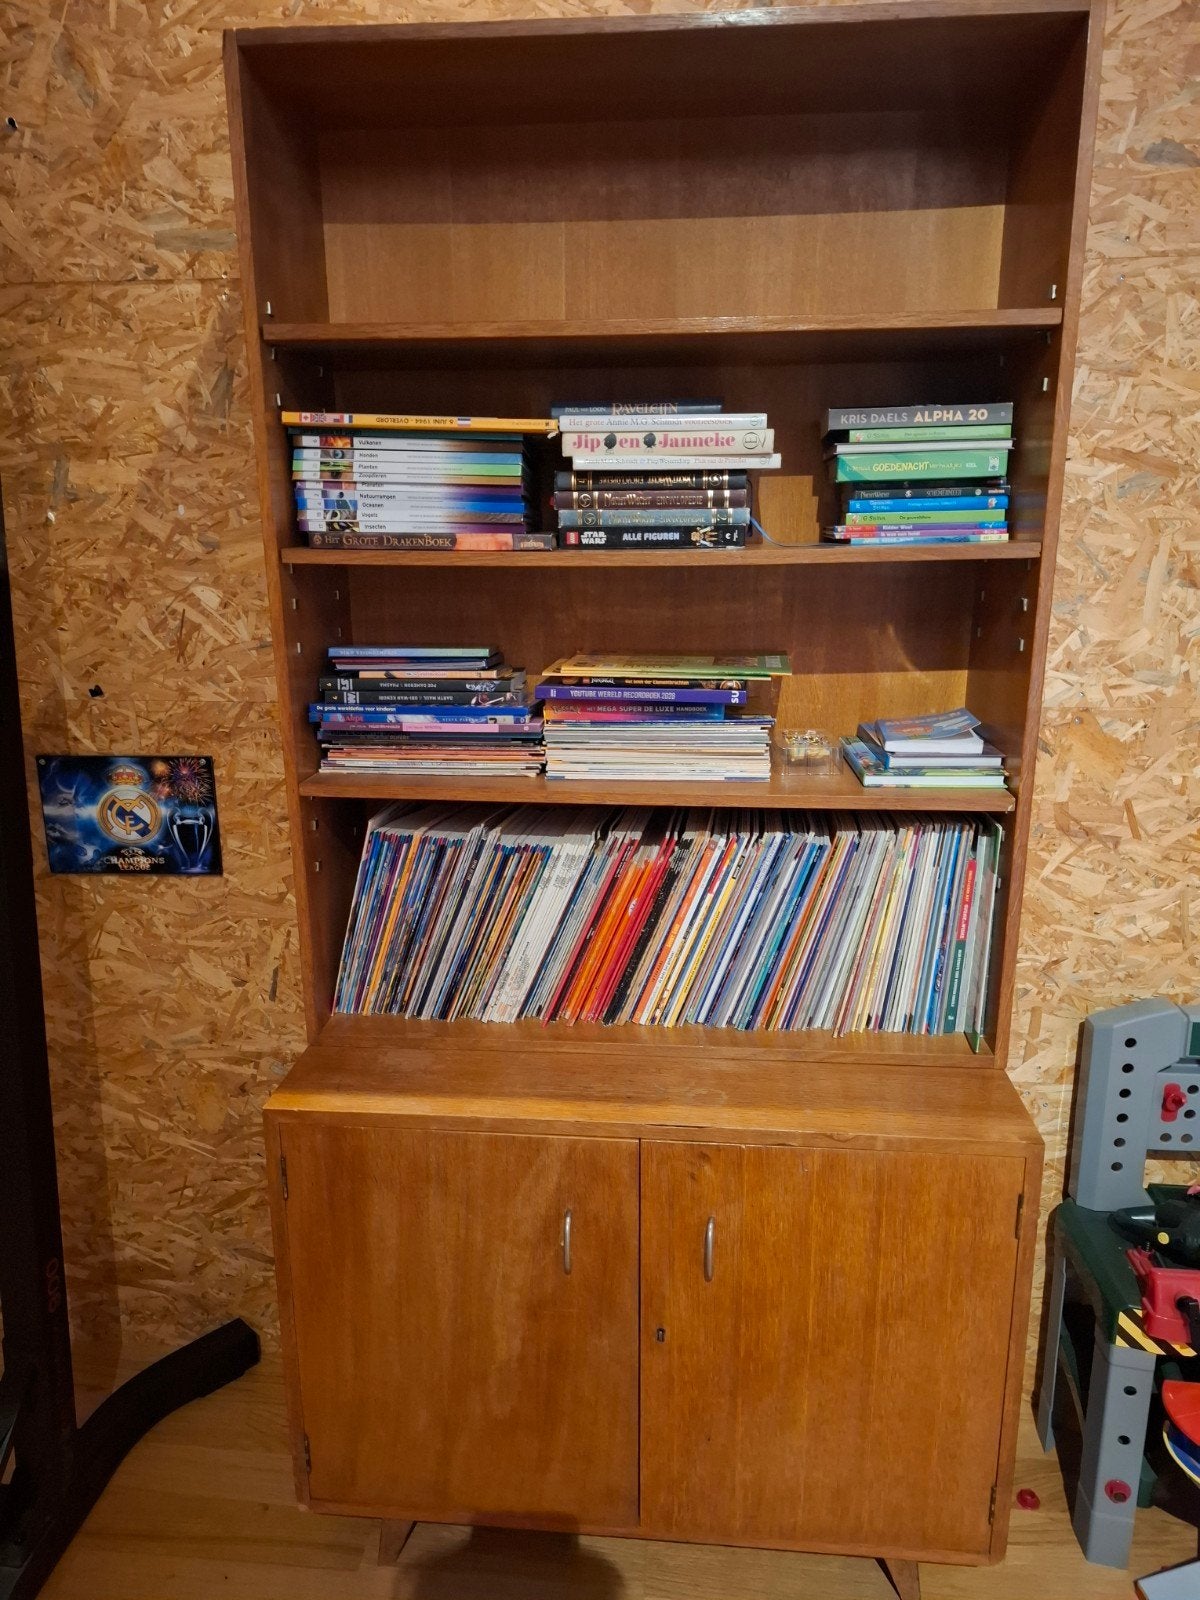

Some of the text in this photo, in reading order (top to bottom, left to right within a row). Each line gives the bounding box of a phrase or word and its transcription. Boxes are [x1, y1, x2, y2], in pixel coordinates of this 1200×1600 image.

[375, 416, 409, 424] OVERLORD
[840, 411, 908, 425] KRIS DAELS
[913, 408, 988, 423] ALPHA 20
[569, 418, 583, 426] Het
[585, 418, 605, 427] grote
[606, 417, 629, 426] Annie
[572, 434, 601, 452] Jip
[618, 437, 641, 448] en
[658, 432, 735, 448] Janneke
[872, 461, 929, 472] GOEDENACHT
[359, 493, 397, 501] Natuurrampen
[581, 537, 607, 545] WARS
[622, 532, 680, 541] ALLE FIGUREN
[570, 689, 597, 698] YOUTUBE
[597, 690, 622, 698] WERELD
